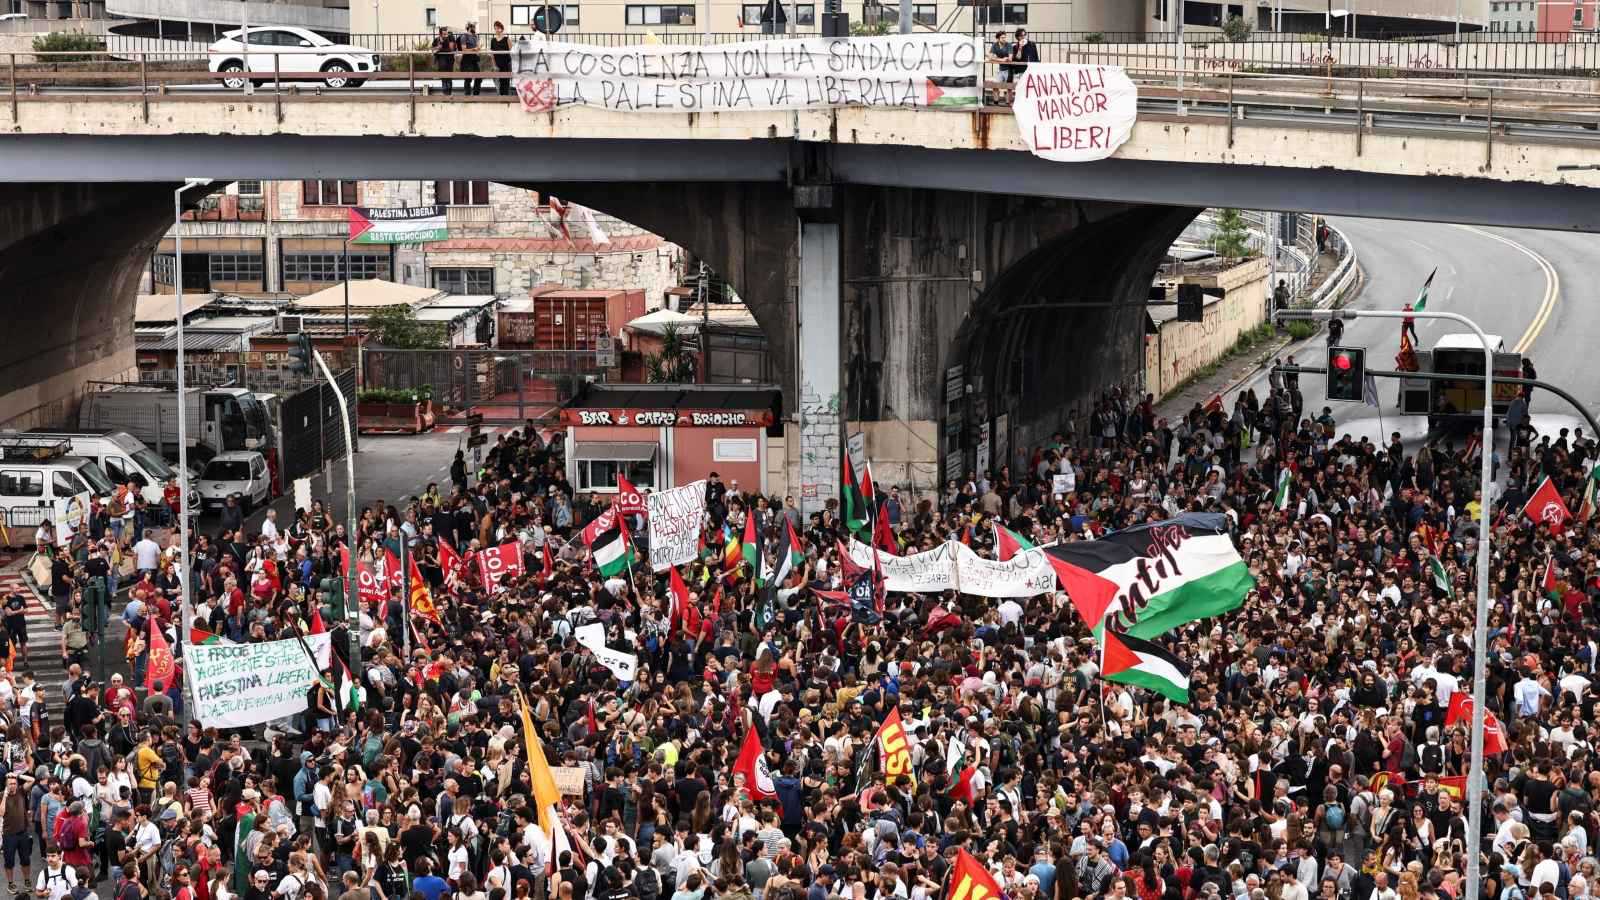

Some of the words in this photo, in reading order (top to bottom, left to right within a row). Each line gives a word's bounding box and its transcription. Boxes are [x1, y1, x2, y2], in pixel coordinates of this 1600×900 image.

[517, 48, 550, 74] LA
[723, 44, 770, 78] NON
[782, 43, 816, 72] HA
[556, 81, 587, 106] LA
[766, 79, 795, 106] VA
[1037, 93, 1108, 121] MANSOR
[1033, 125, 1111, 151] LIBERI
[369, 208, 408, 218] PALESTINA
[409, 207, 434, 217] LIBERA
[370, 231, 394, 241] BASTA
[395, 230, 434, 241] GENOCIDIO
[579, 411, 613, 425] BAR
